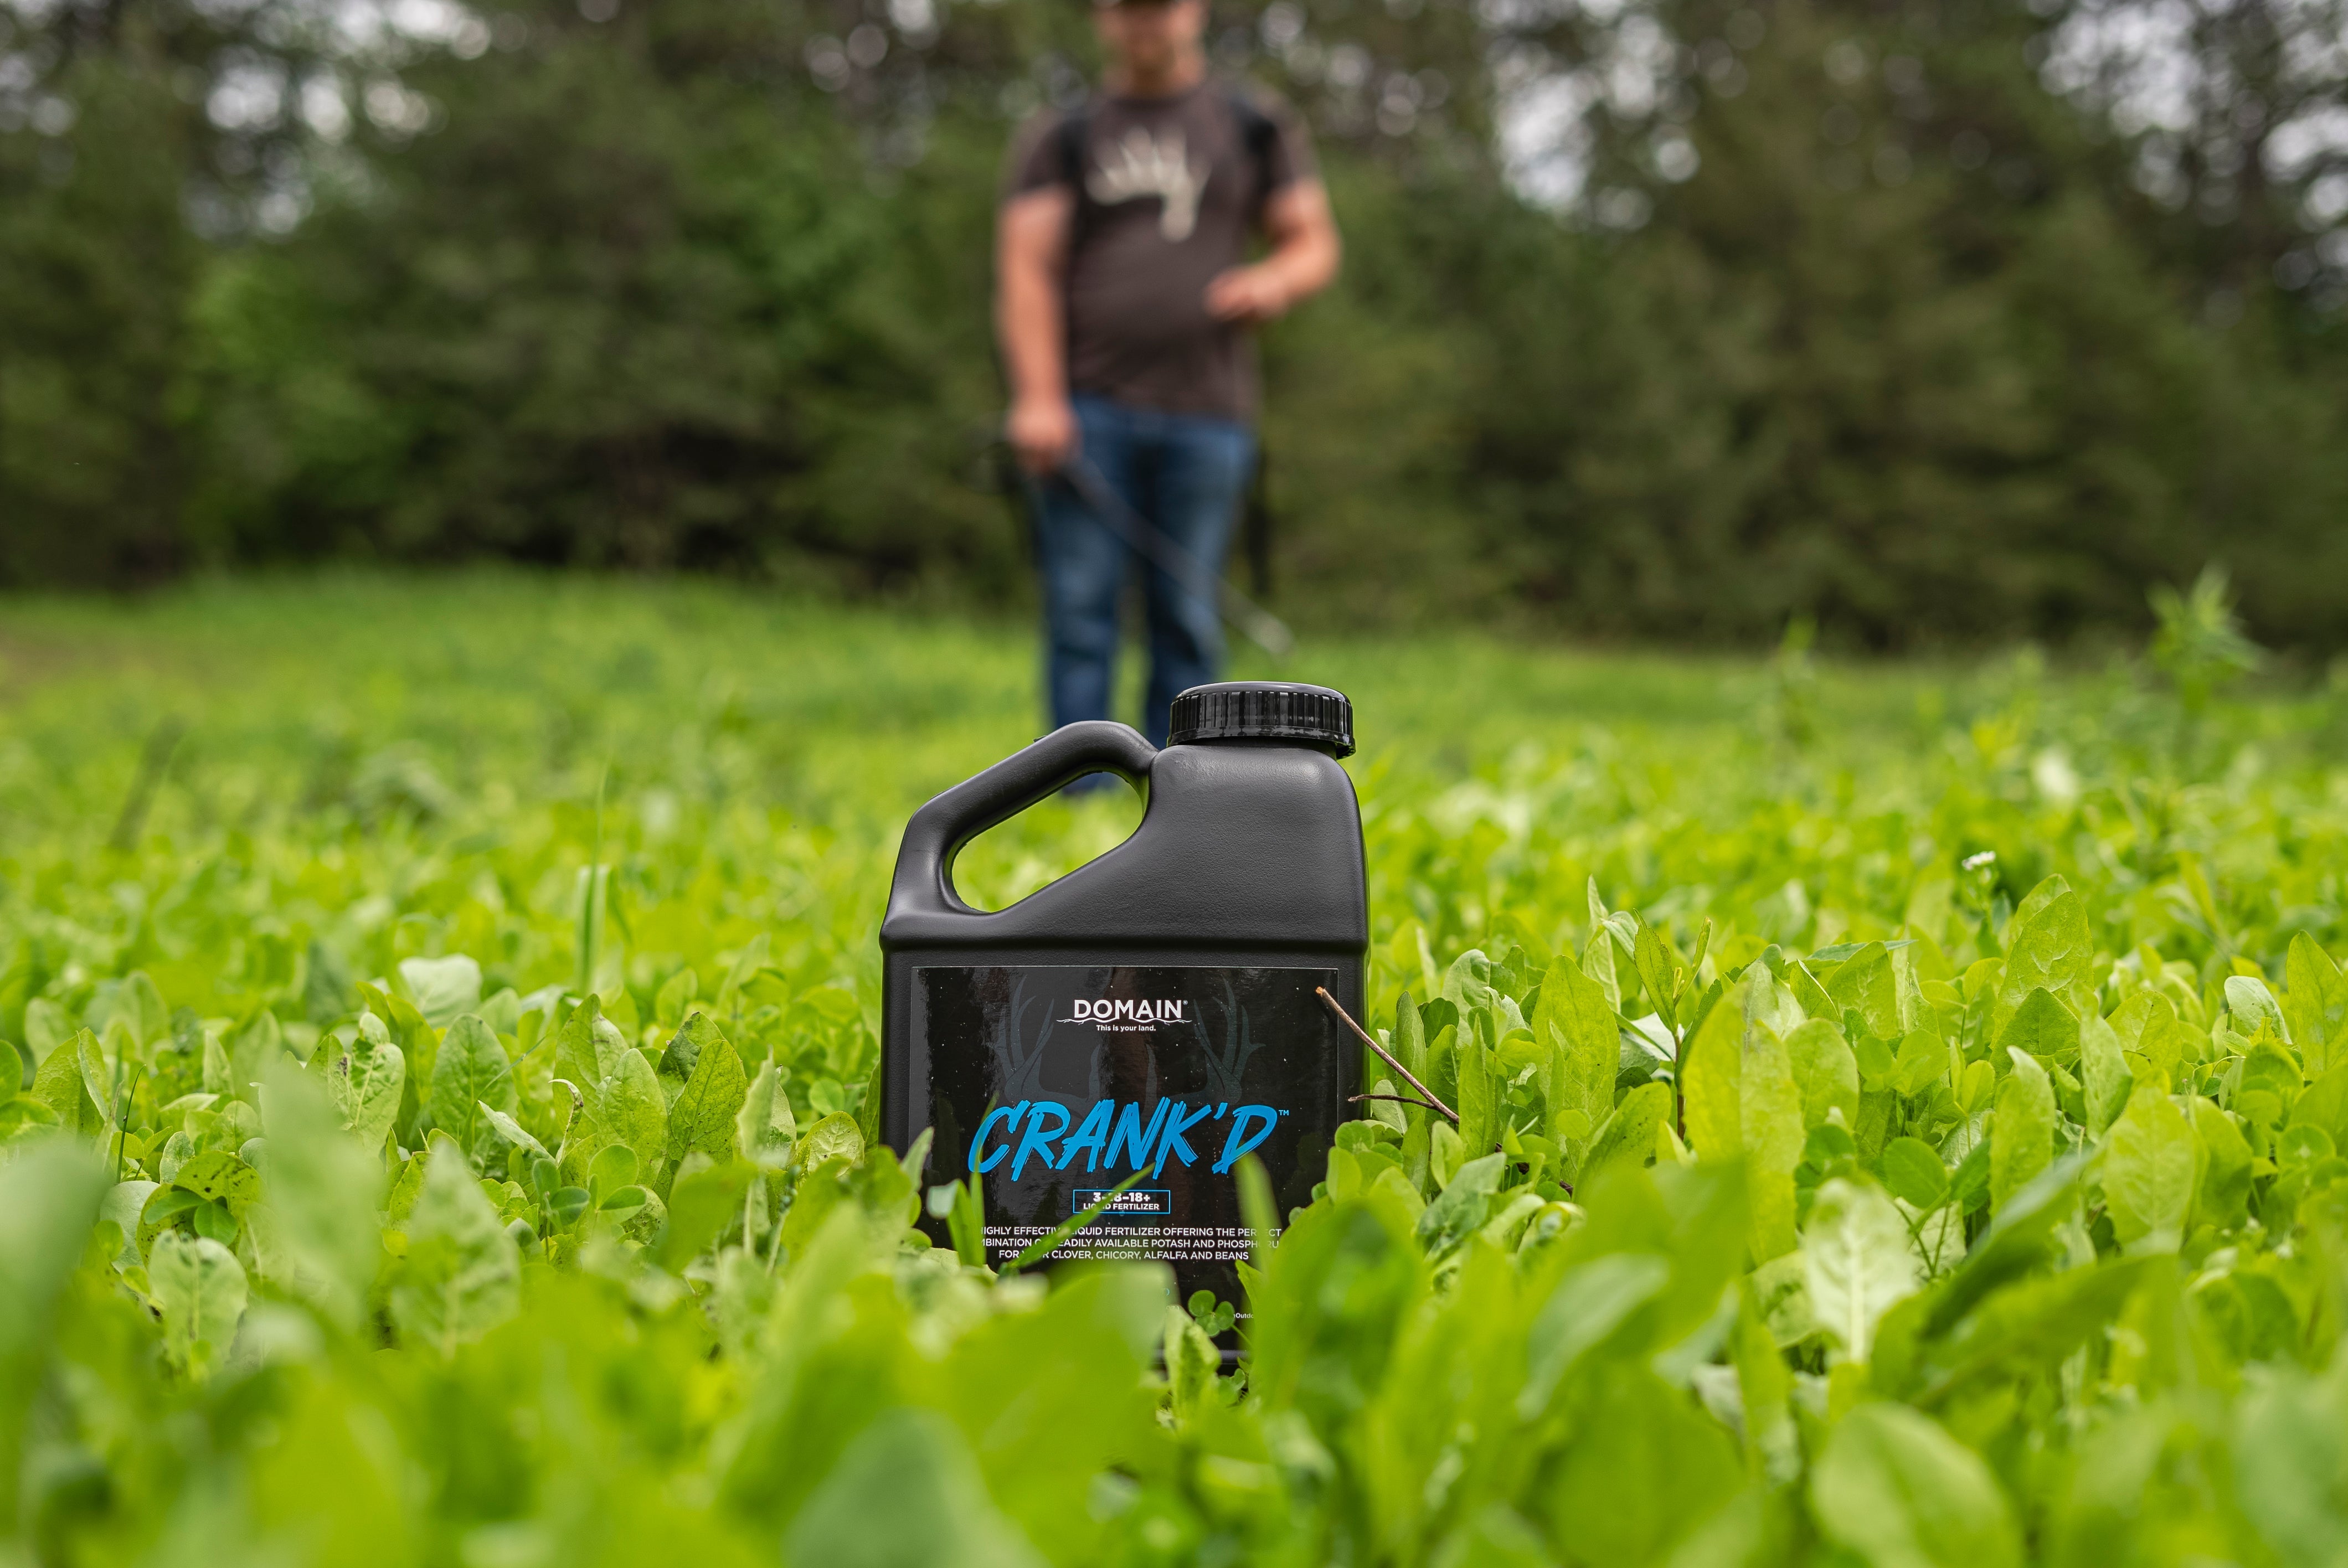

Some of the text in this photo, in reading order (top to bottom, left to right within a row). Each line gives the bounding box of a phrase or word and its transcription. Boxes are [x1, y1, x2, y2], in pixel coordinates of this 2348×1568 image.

[1072, 1227, 1103, 1236] IQUID
[1105, 1227, 1161, 1236] FERTILIZER
[1163, 1227, 1213, 1236] OFFERING
[1216, 1228, 1235, 1236] THE
[1238, 1228, 1282, 1237] PERCT
[1094, 1239, 1149, 1247] AVAILABLE
[1151, 1239, 1191, 1248] POTASH
[1193, 1240, 1215, 1248] AND
[998, 1250, 1019, 1258] FOR
[1052, 1250, 1094, 1260] CLOVER,
[1095, 1251, 1141, 1260] CHICORY,
[1144, 1251, 1188, 1260] ALFALFA
[1191, 1251, 1213, 1260] AND
[1215, 1251, 1249, 1260] BEANS
